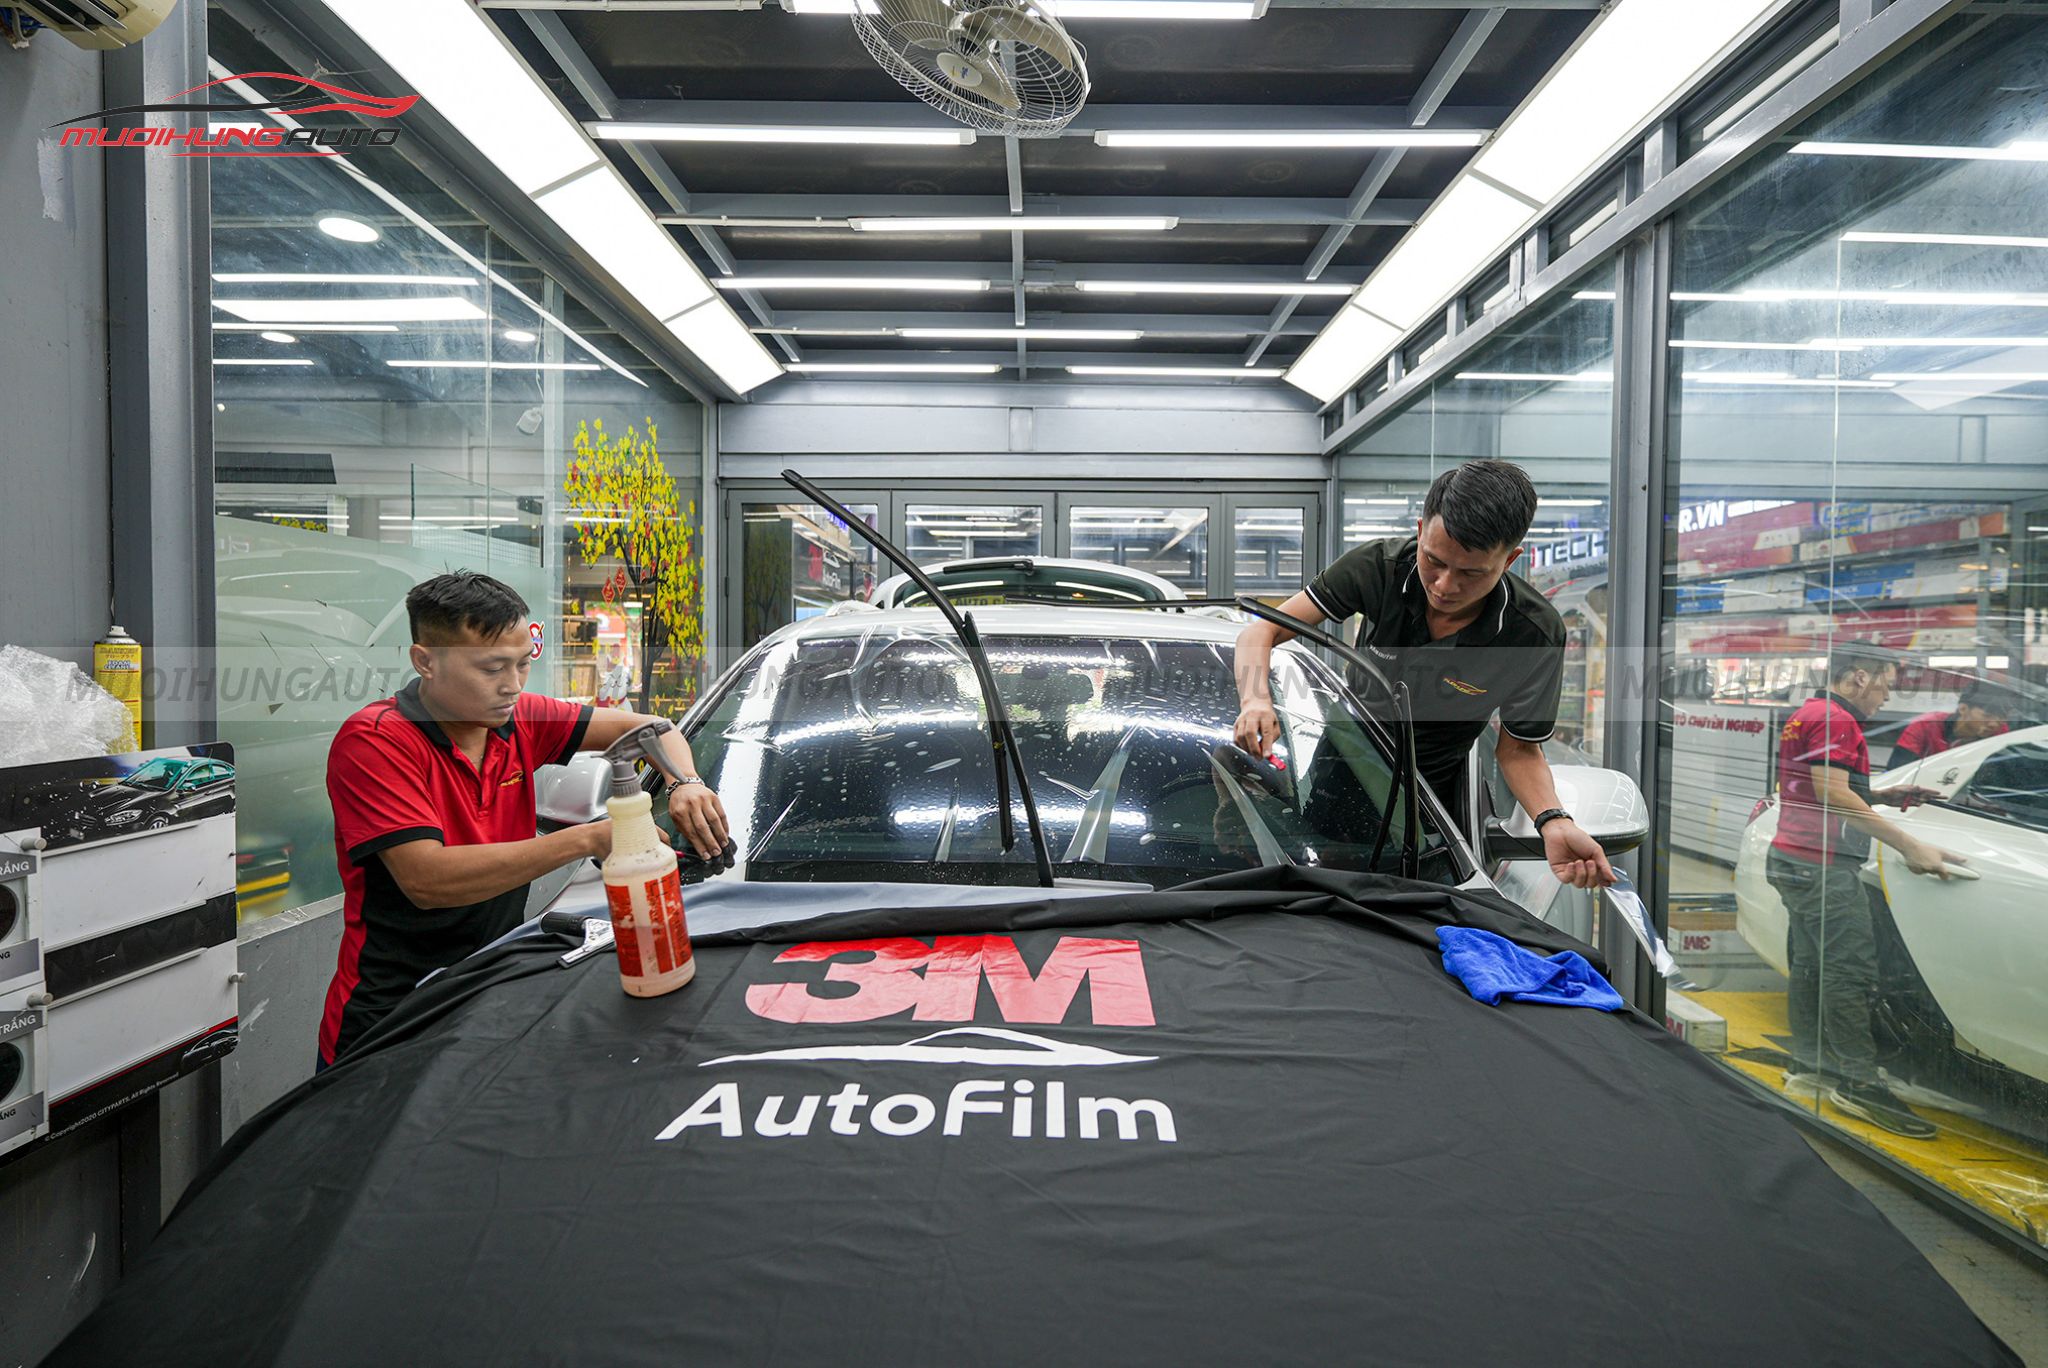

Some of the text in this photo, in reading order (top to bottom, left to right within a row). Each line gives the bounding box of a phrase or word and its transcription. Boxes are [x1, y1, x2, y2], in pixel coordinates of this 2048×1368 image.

[1678, 499, 1725, 533] R.VN
[745, 934, 1156, 1027] 3M
[655, 1079, 1177, 1142] AutoFilm
